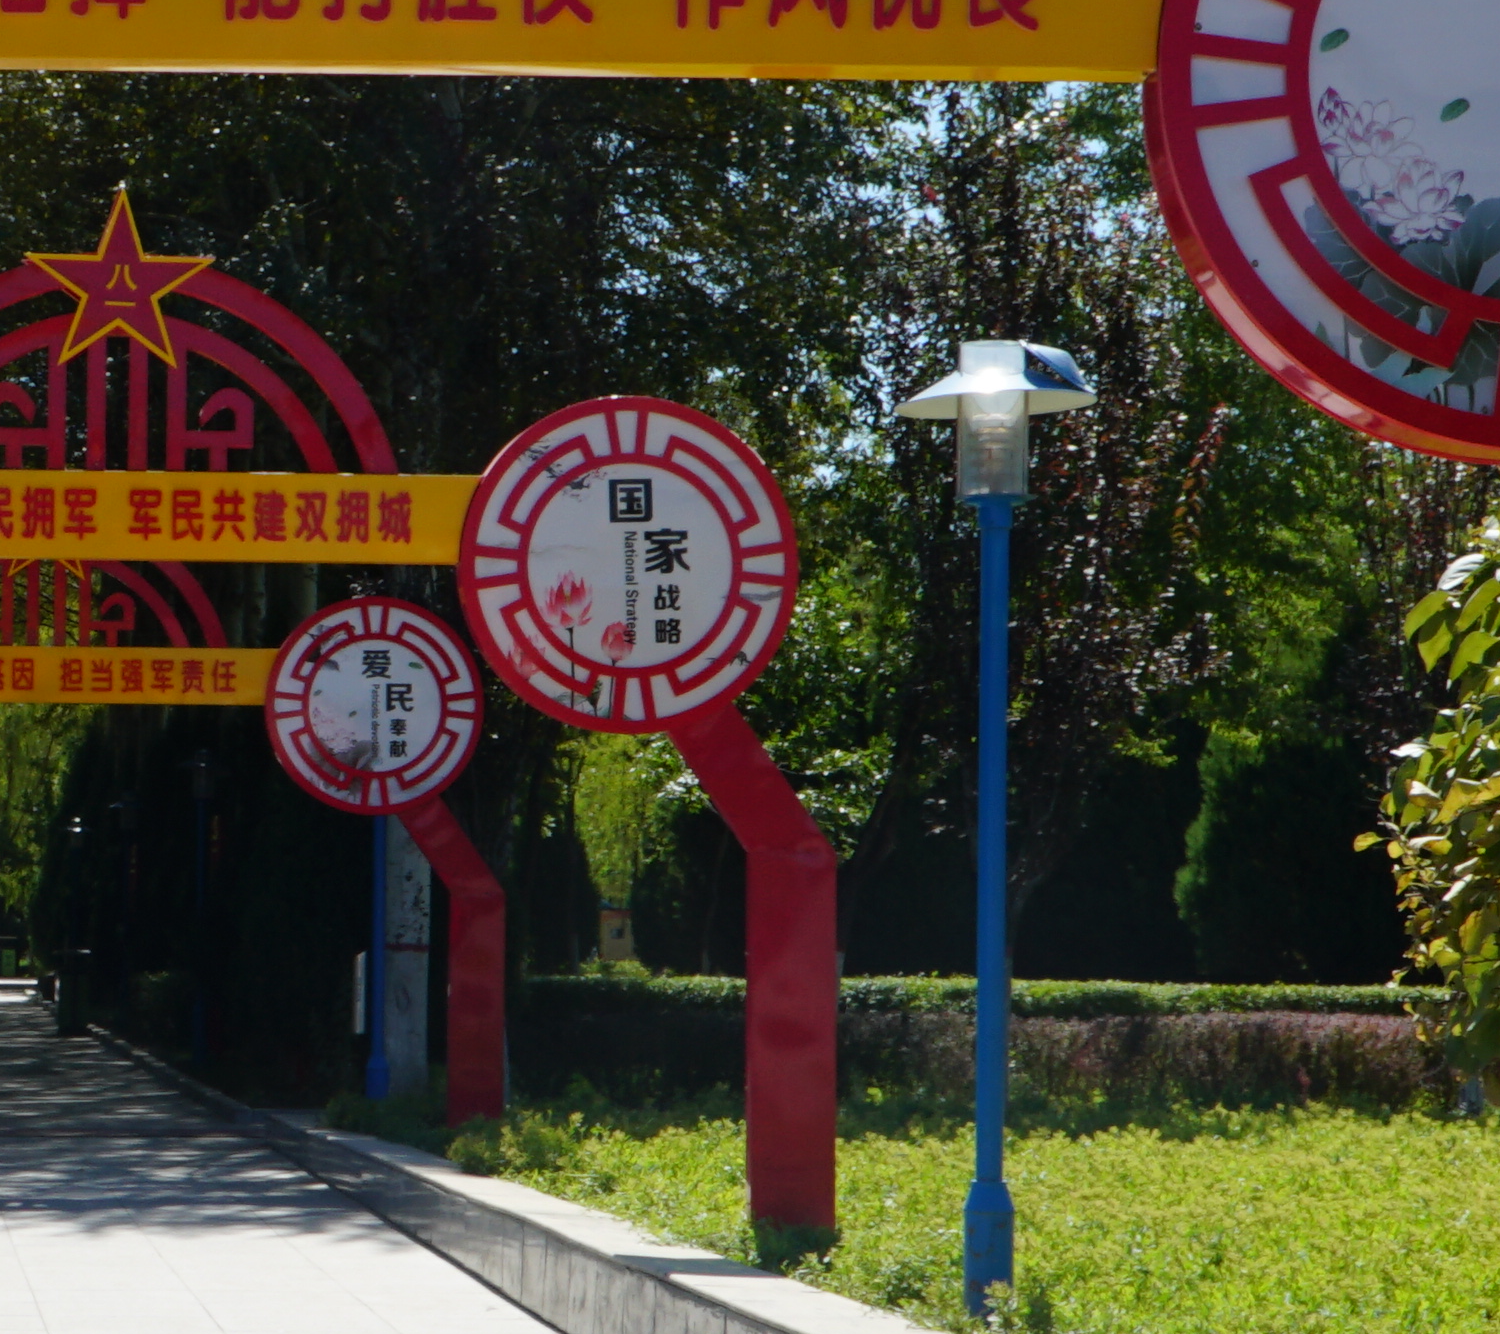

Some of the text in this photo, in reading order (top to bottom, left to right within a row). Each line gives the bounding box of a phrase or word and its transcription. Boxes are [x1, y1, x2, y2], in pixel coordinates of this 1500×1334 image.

[104, 264, 138, 306] 八一
[128, 489, 412, 544] 军民共建双拥城
[608, 478, 691, 644] 国家战略
[623, 531, 639, 645] National Strategy
[60, 658, 237, 694] 担当强军责任
[362, 649, 414, 757] 爱民奉献
